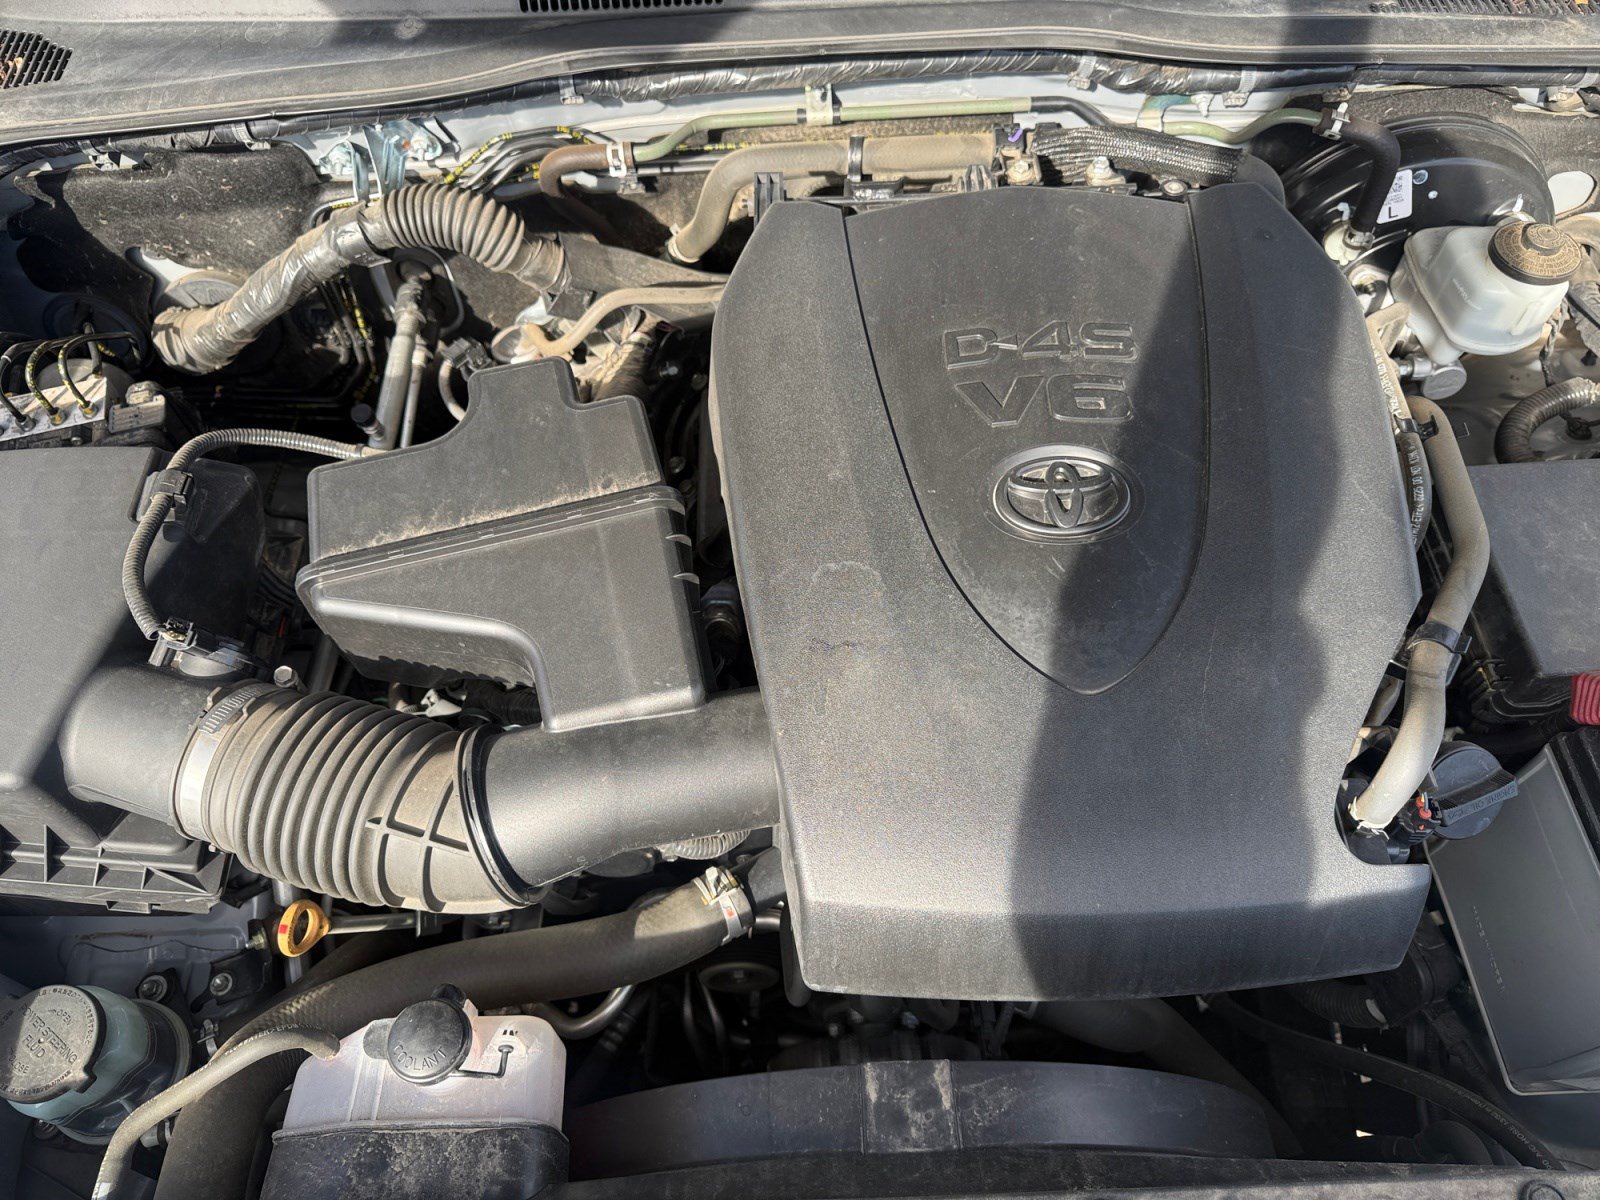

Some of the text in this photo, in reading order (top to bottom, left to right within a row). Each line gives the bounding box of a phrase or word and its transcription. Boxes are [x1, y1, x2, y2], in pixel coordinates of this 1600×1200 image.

[1388, 206, 1399, 219] L
[942, 319, 1139, 370] D-4S
[953, 373, 1135, 428] V6
[56, 1009, 73, 1026] OPEN
[21, 1003, 46, 1032] POWER
[42, 1027, 79, 1066] STEERING
[22, 1034, 46, 1059] FLUID
[393, 1044, 447, 1071] COOLANT
